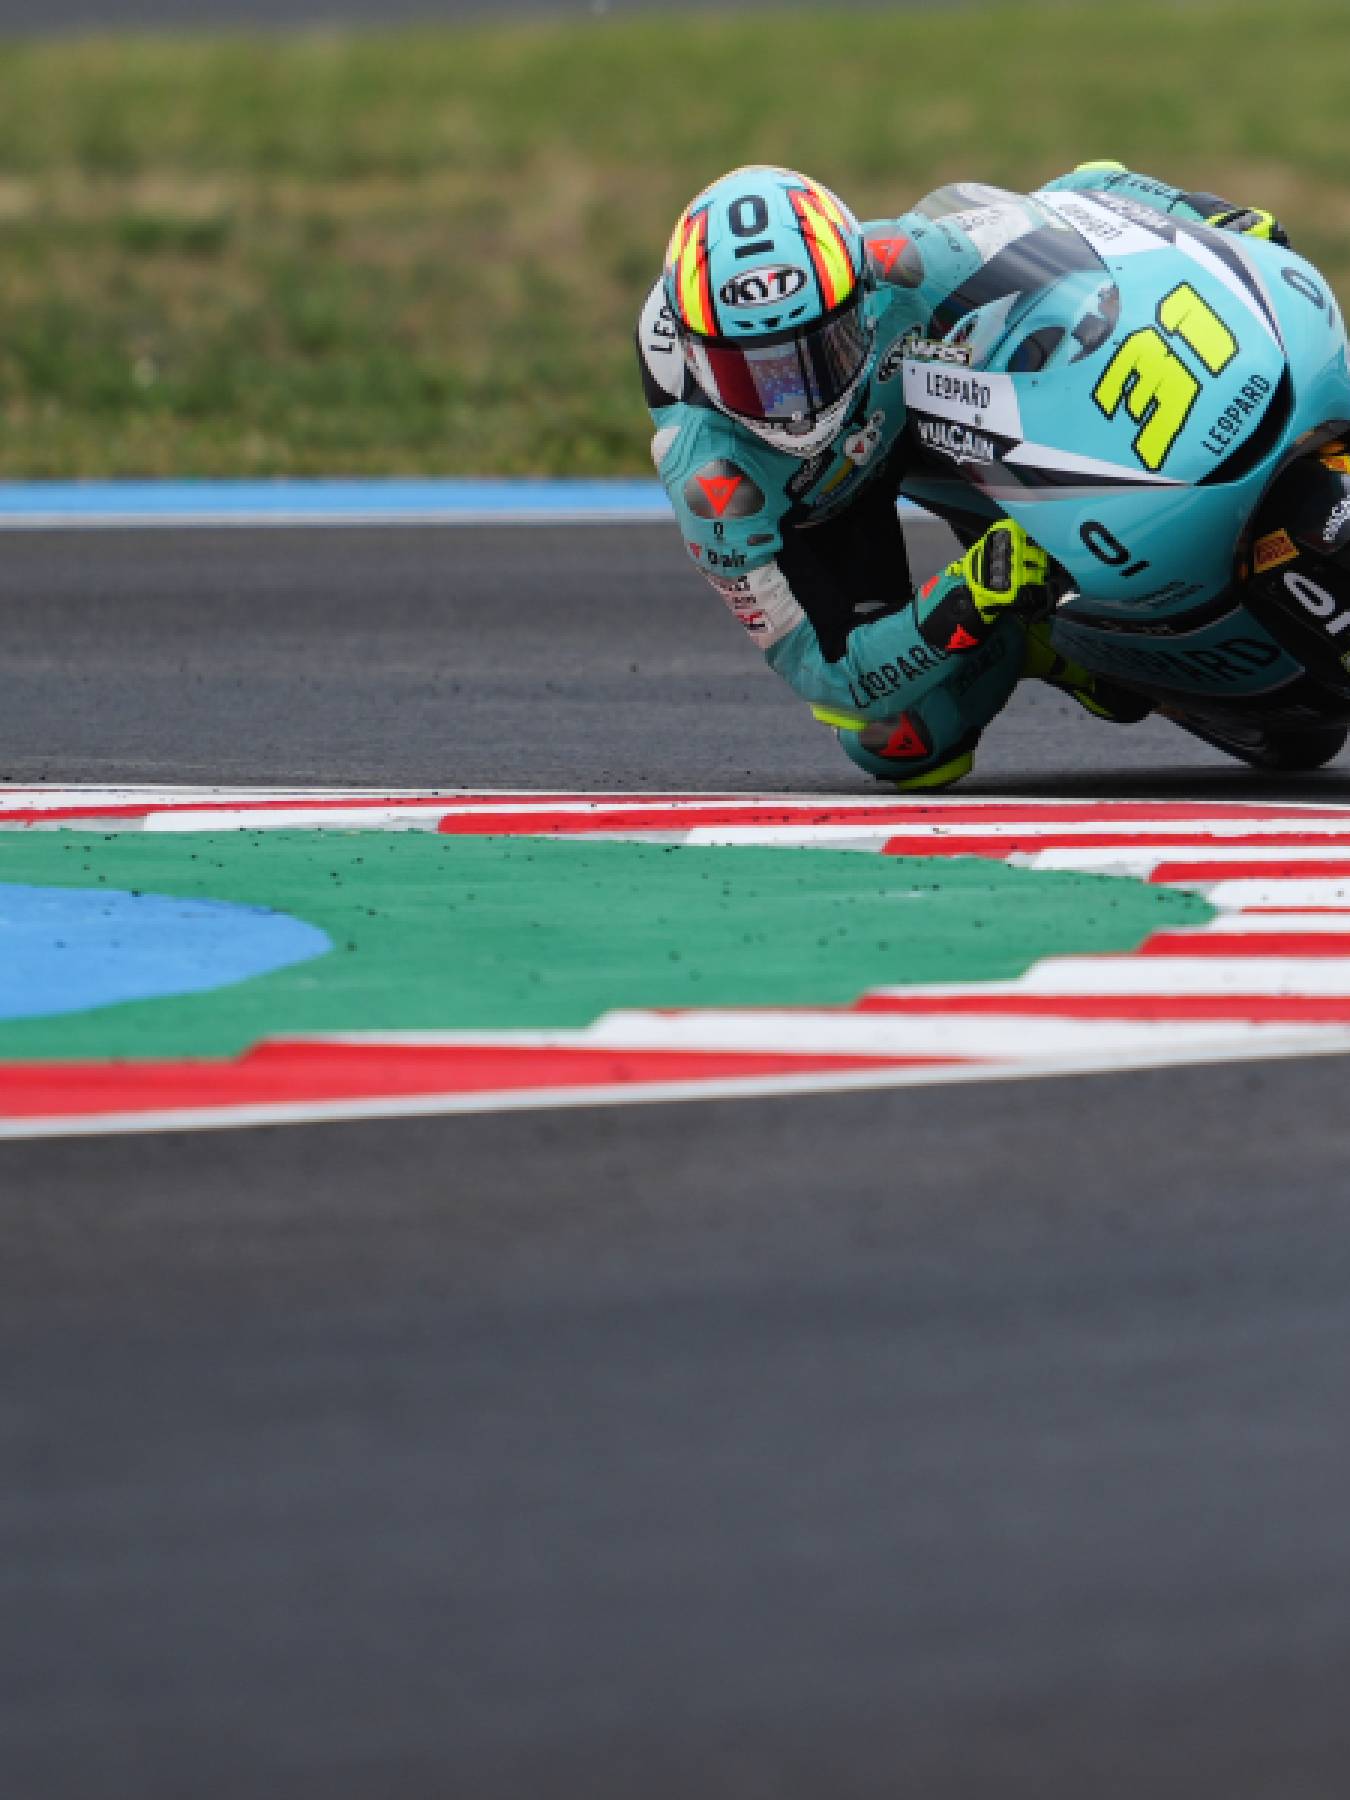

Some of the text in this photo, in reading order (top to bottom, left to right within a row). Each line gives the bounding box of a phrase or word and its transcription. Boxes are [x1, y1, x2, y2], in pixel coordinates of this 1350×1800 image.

[720, 267, 801, 306] KYT
[926, 371, 991, 408] LEOPARD
[1091, 281, 1240, 472] 31
[1200, 374, 1271, 457] LEOPARD
[918, 419, 994, 460] VULCAIN
